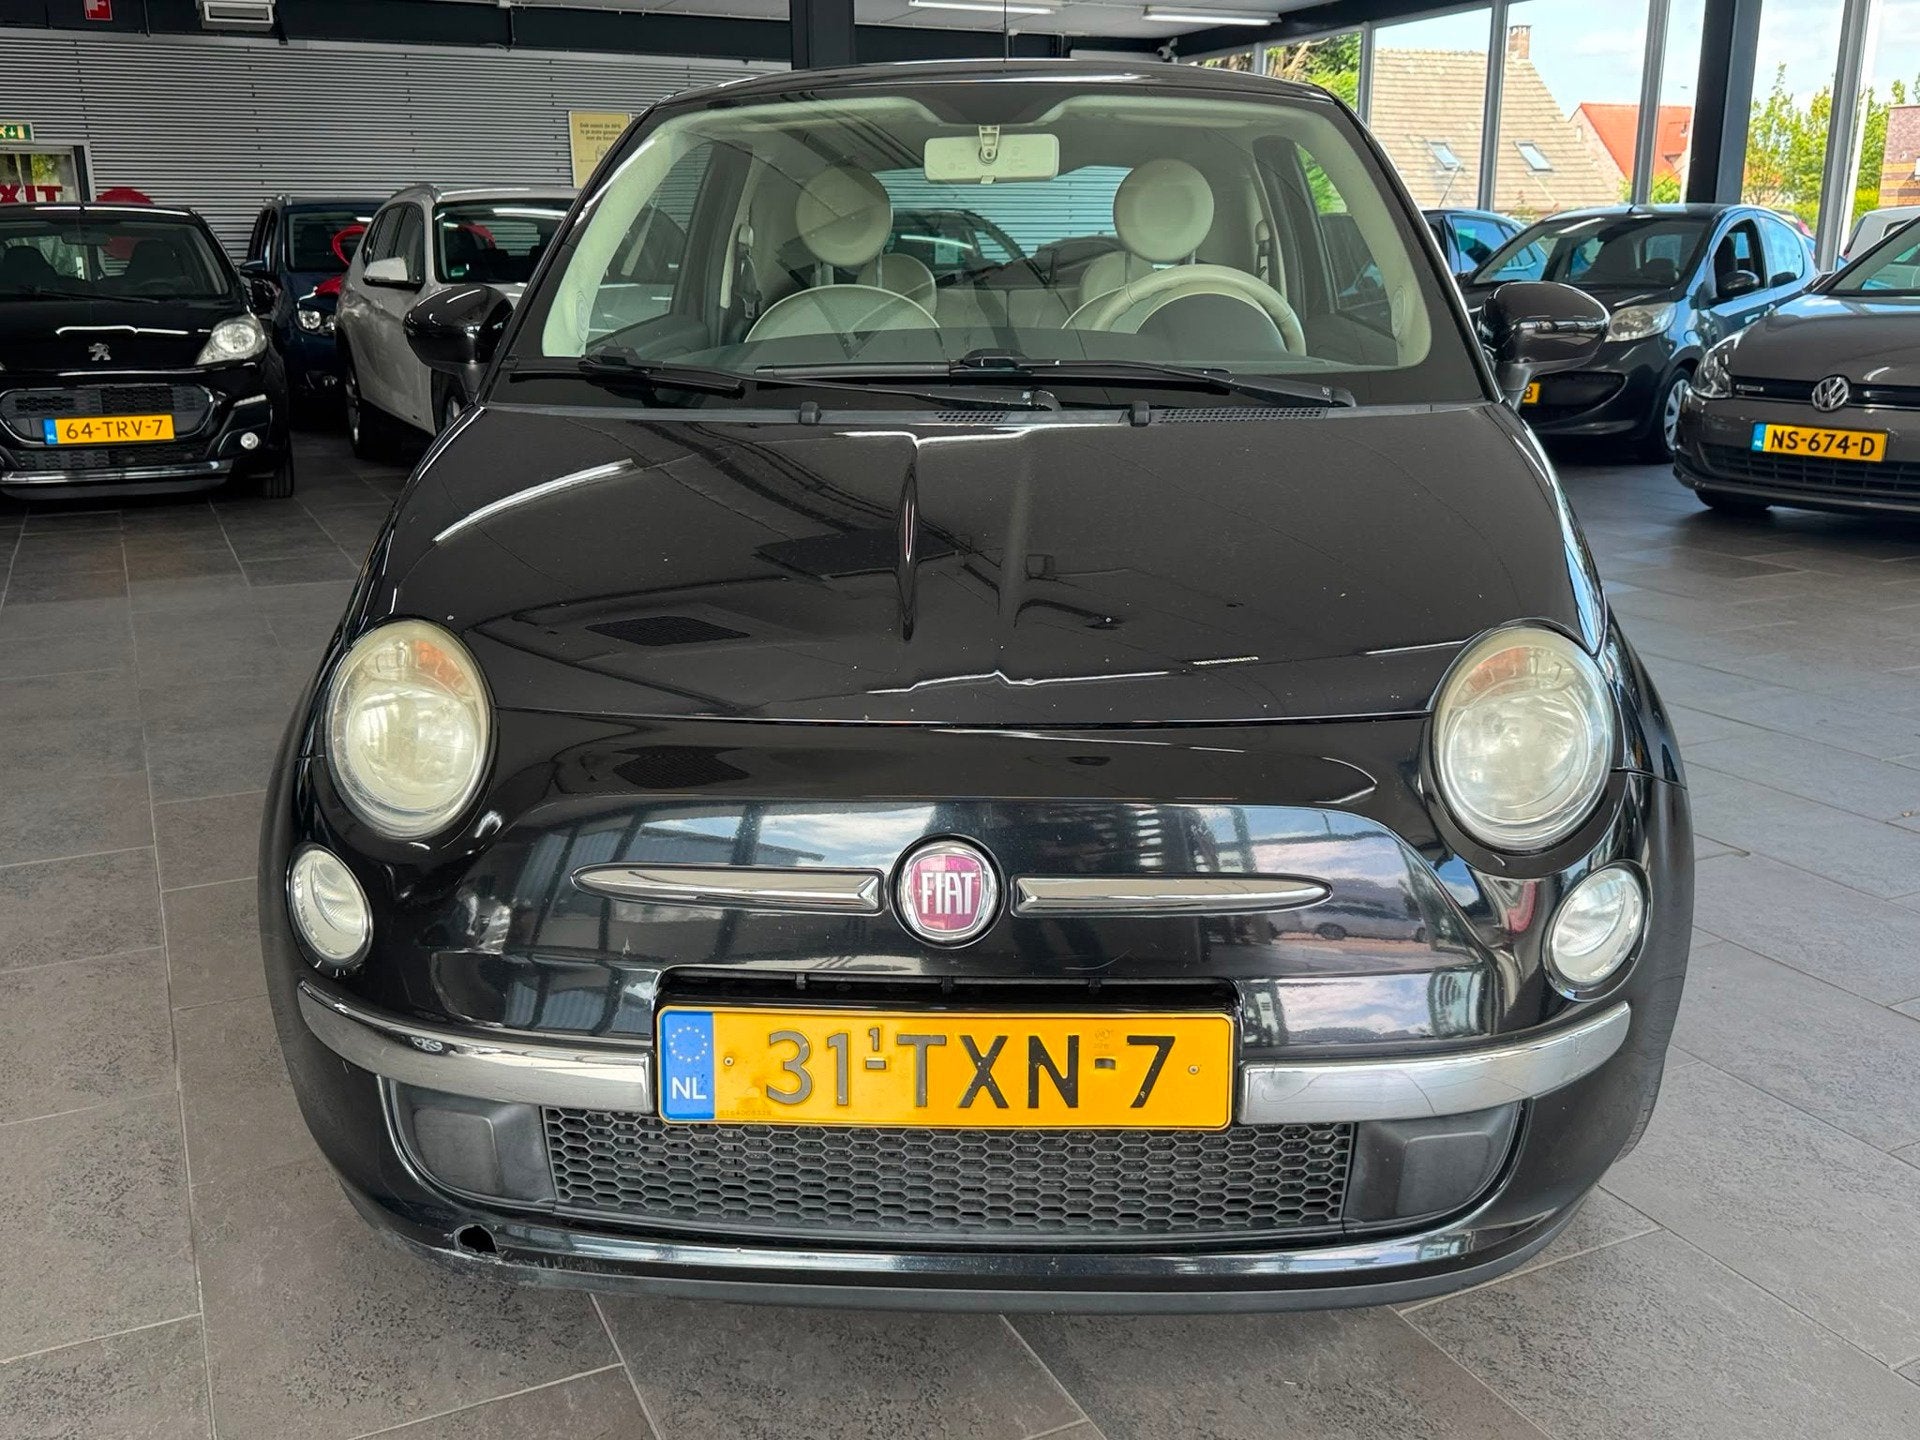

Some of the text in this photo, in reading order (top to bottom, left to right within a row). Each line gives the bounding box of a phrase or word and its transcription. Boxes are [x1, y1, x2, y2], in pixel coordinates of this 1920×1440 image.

[65, 419, 164, 440] 64-TRV-7
[1770, 429, 1876, 457] NS-674-D
[920, 871, 977, 915] FIAT
[671, 1077, 708, 1100] NL
